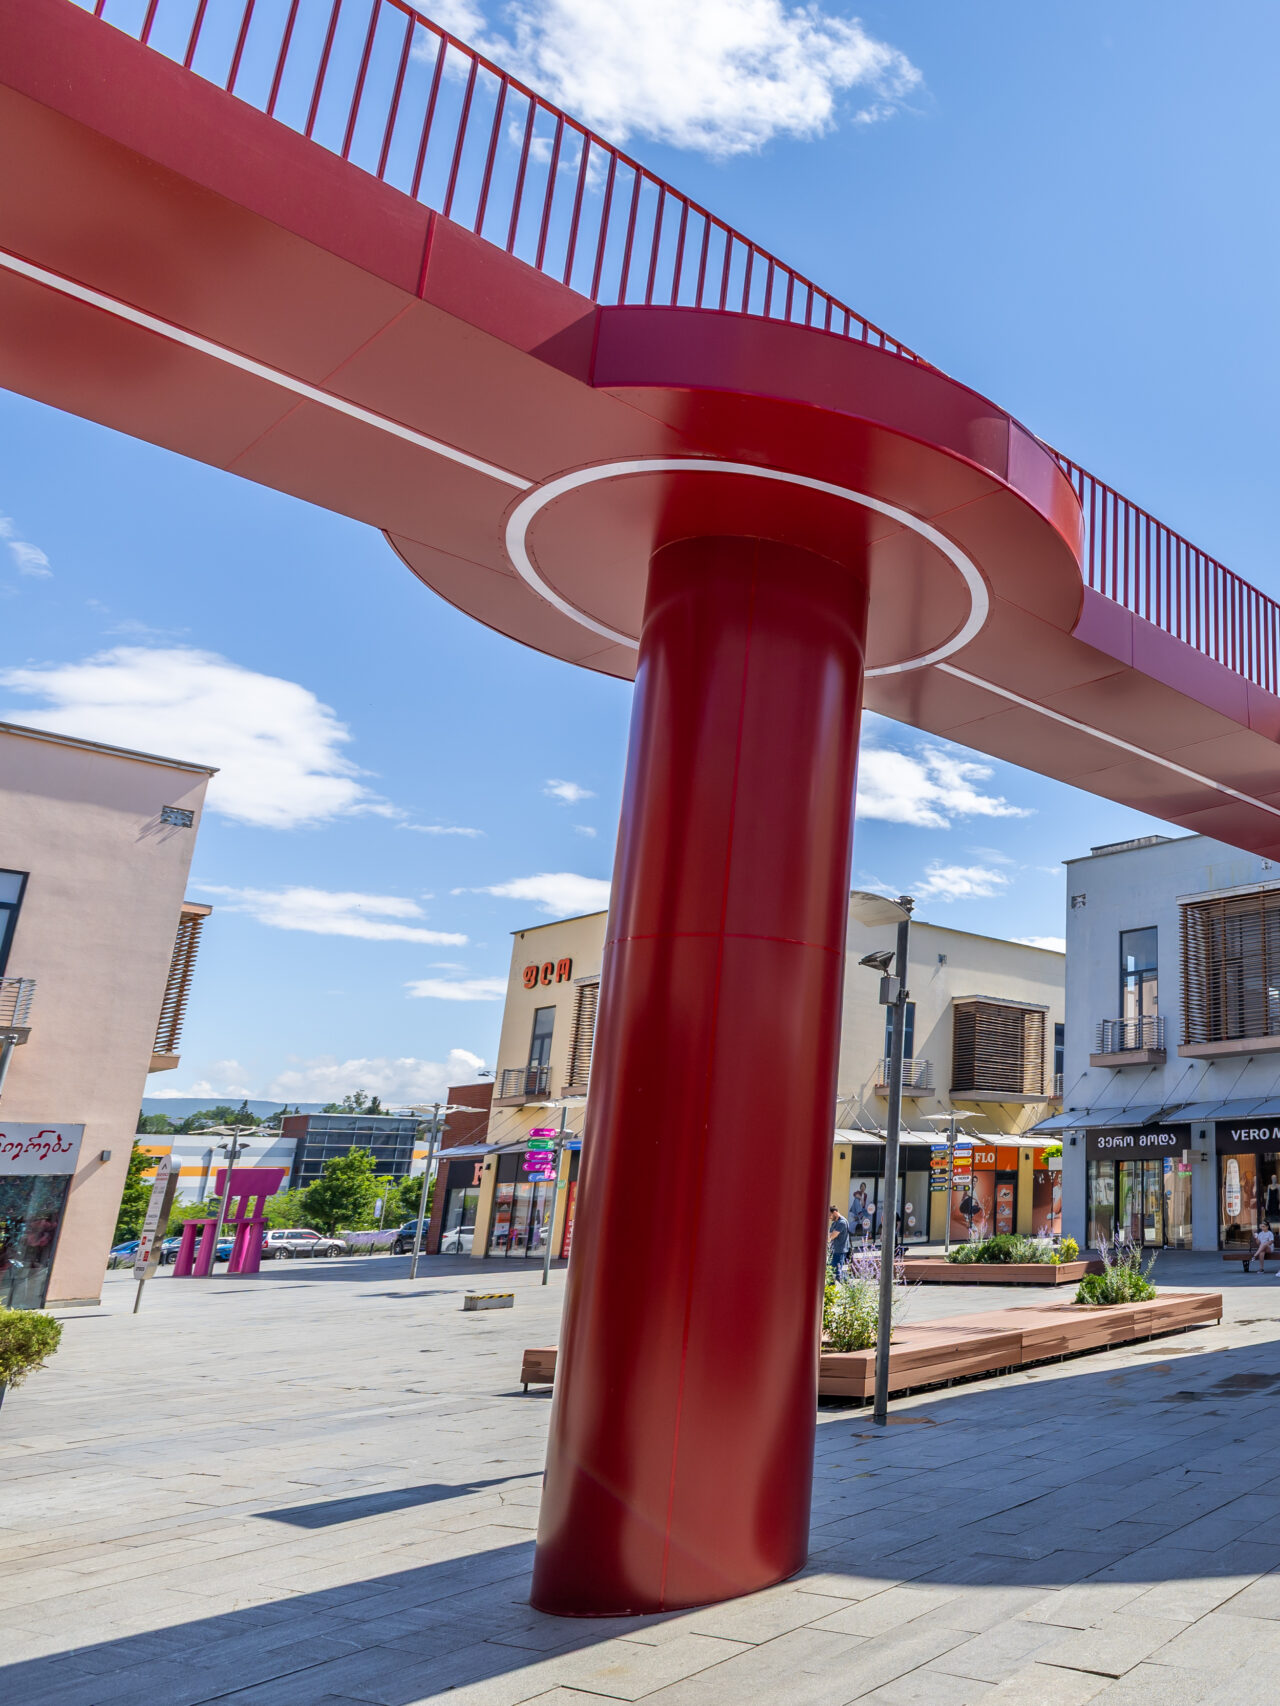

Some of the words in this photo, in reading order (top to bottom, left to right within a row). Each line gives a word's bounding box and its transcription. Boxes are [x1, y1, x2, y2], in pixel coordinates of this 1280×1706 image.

[1098, 1135, 1134, 1148] ვერო
[1139, 1134, 1177, 1147] მოდა
[1231, 1129, 1269, 1141] VERO
[975, 1152, 995, 1163] FLO
